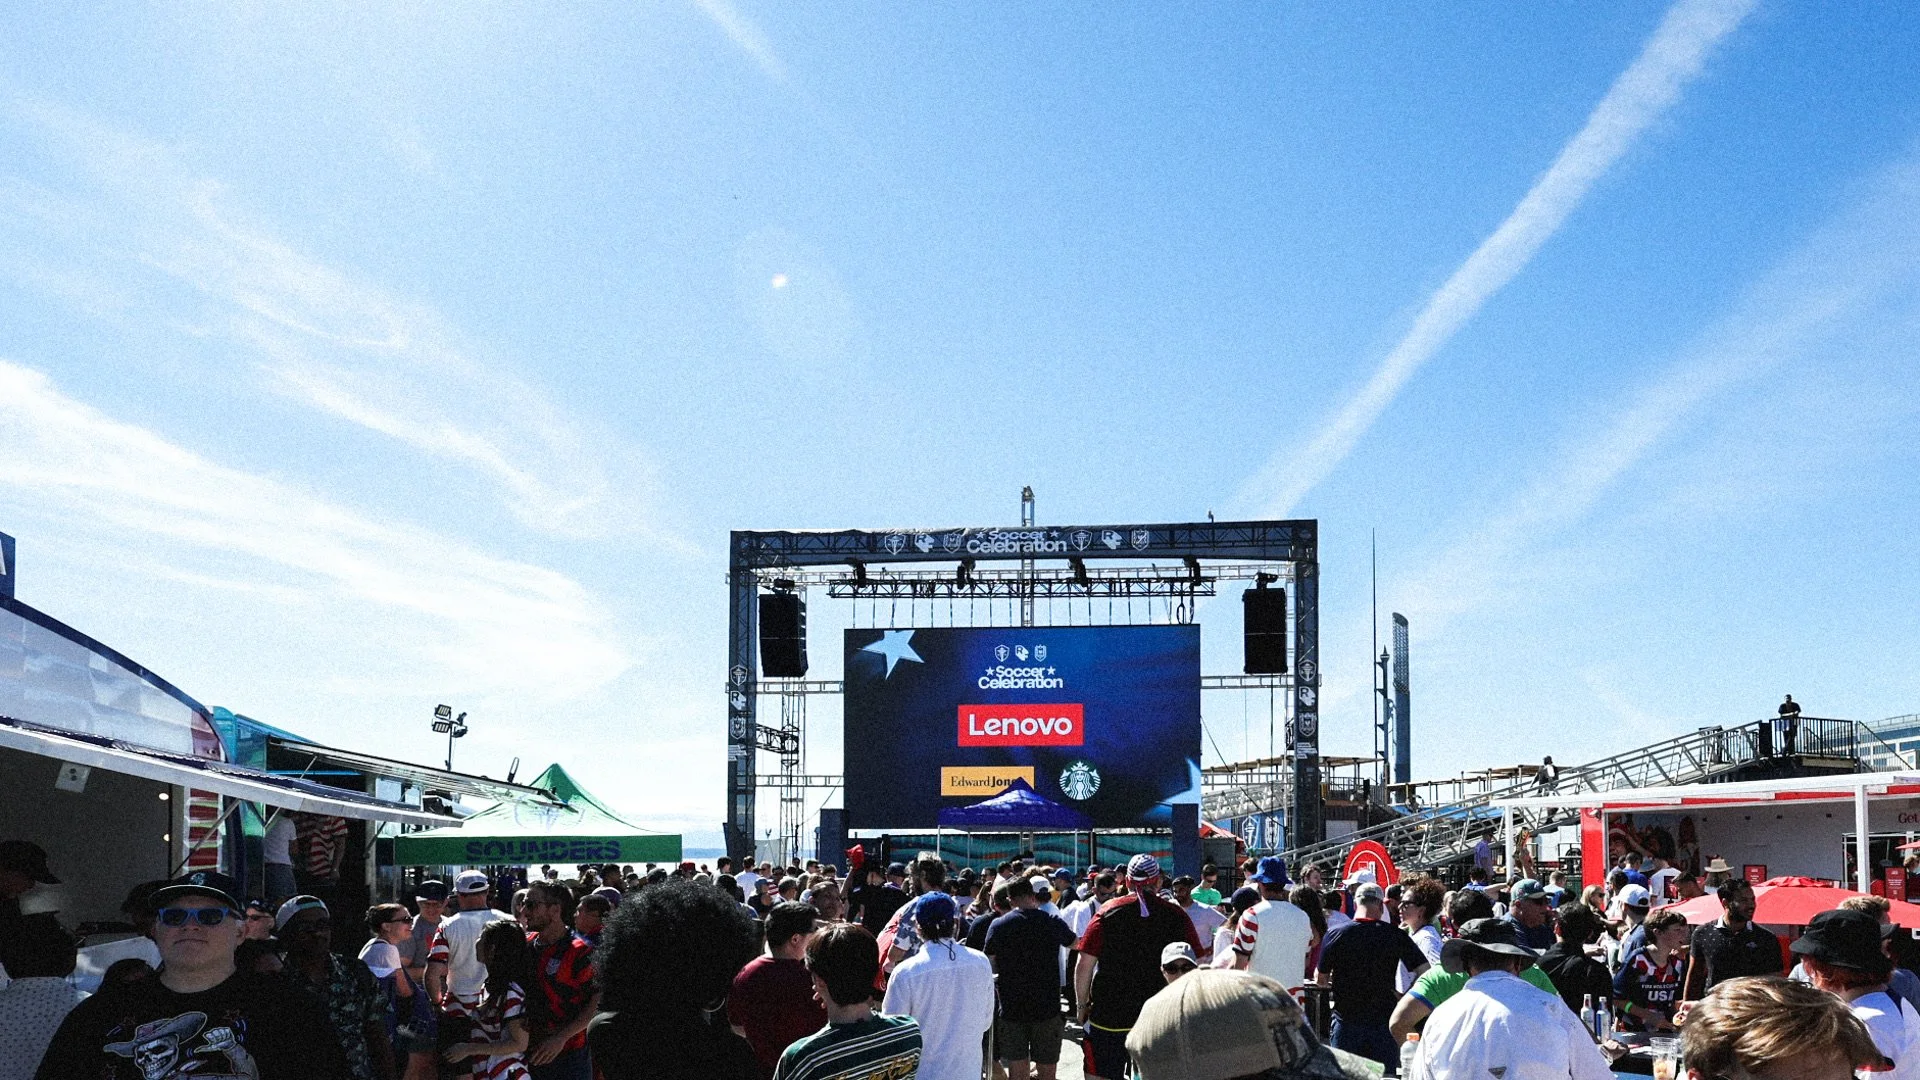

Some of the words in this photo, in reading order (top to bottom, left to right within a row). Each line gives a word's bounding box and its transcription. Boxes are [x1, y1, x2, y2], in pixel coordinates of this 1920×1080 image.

[988, 530, 1046, 541] Soccer
[966, 539, 1067, 554] Celebration
[996, 665, 1046, 678] Soccer
[978, 676, 1064, 689] Celebration
[969, 713, 1073, 736] Lenovo
[951, 776, 990, 787] Edward
[465, 840, 621, 862] SOUNDERS
